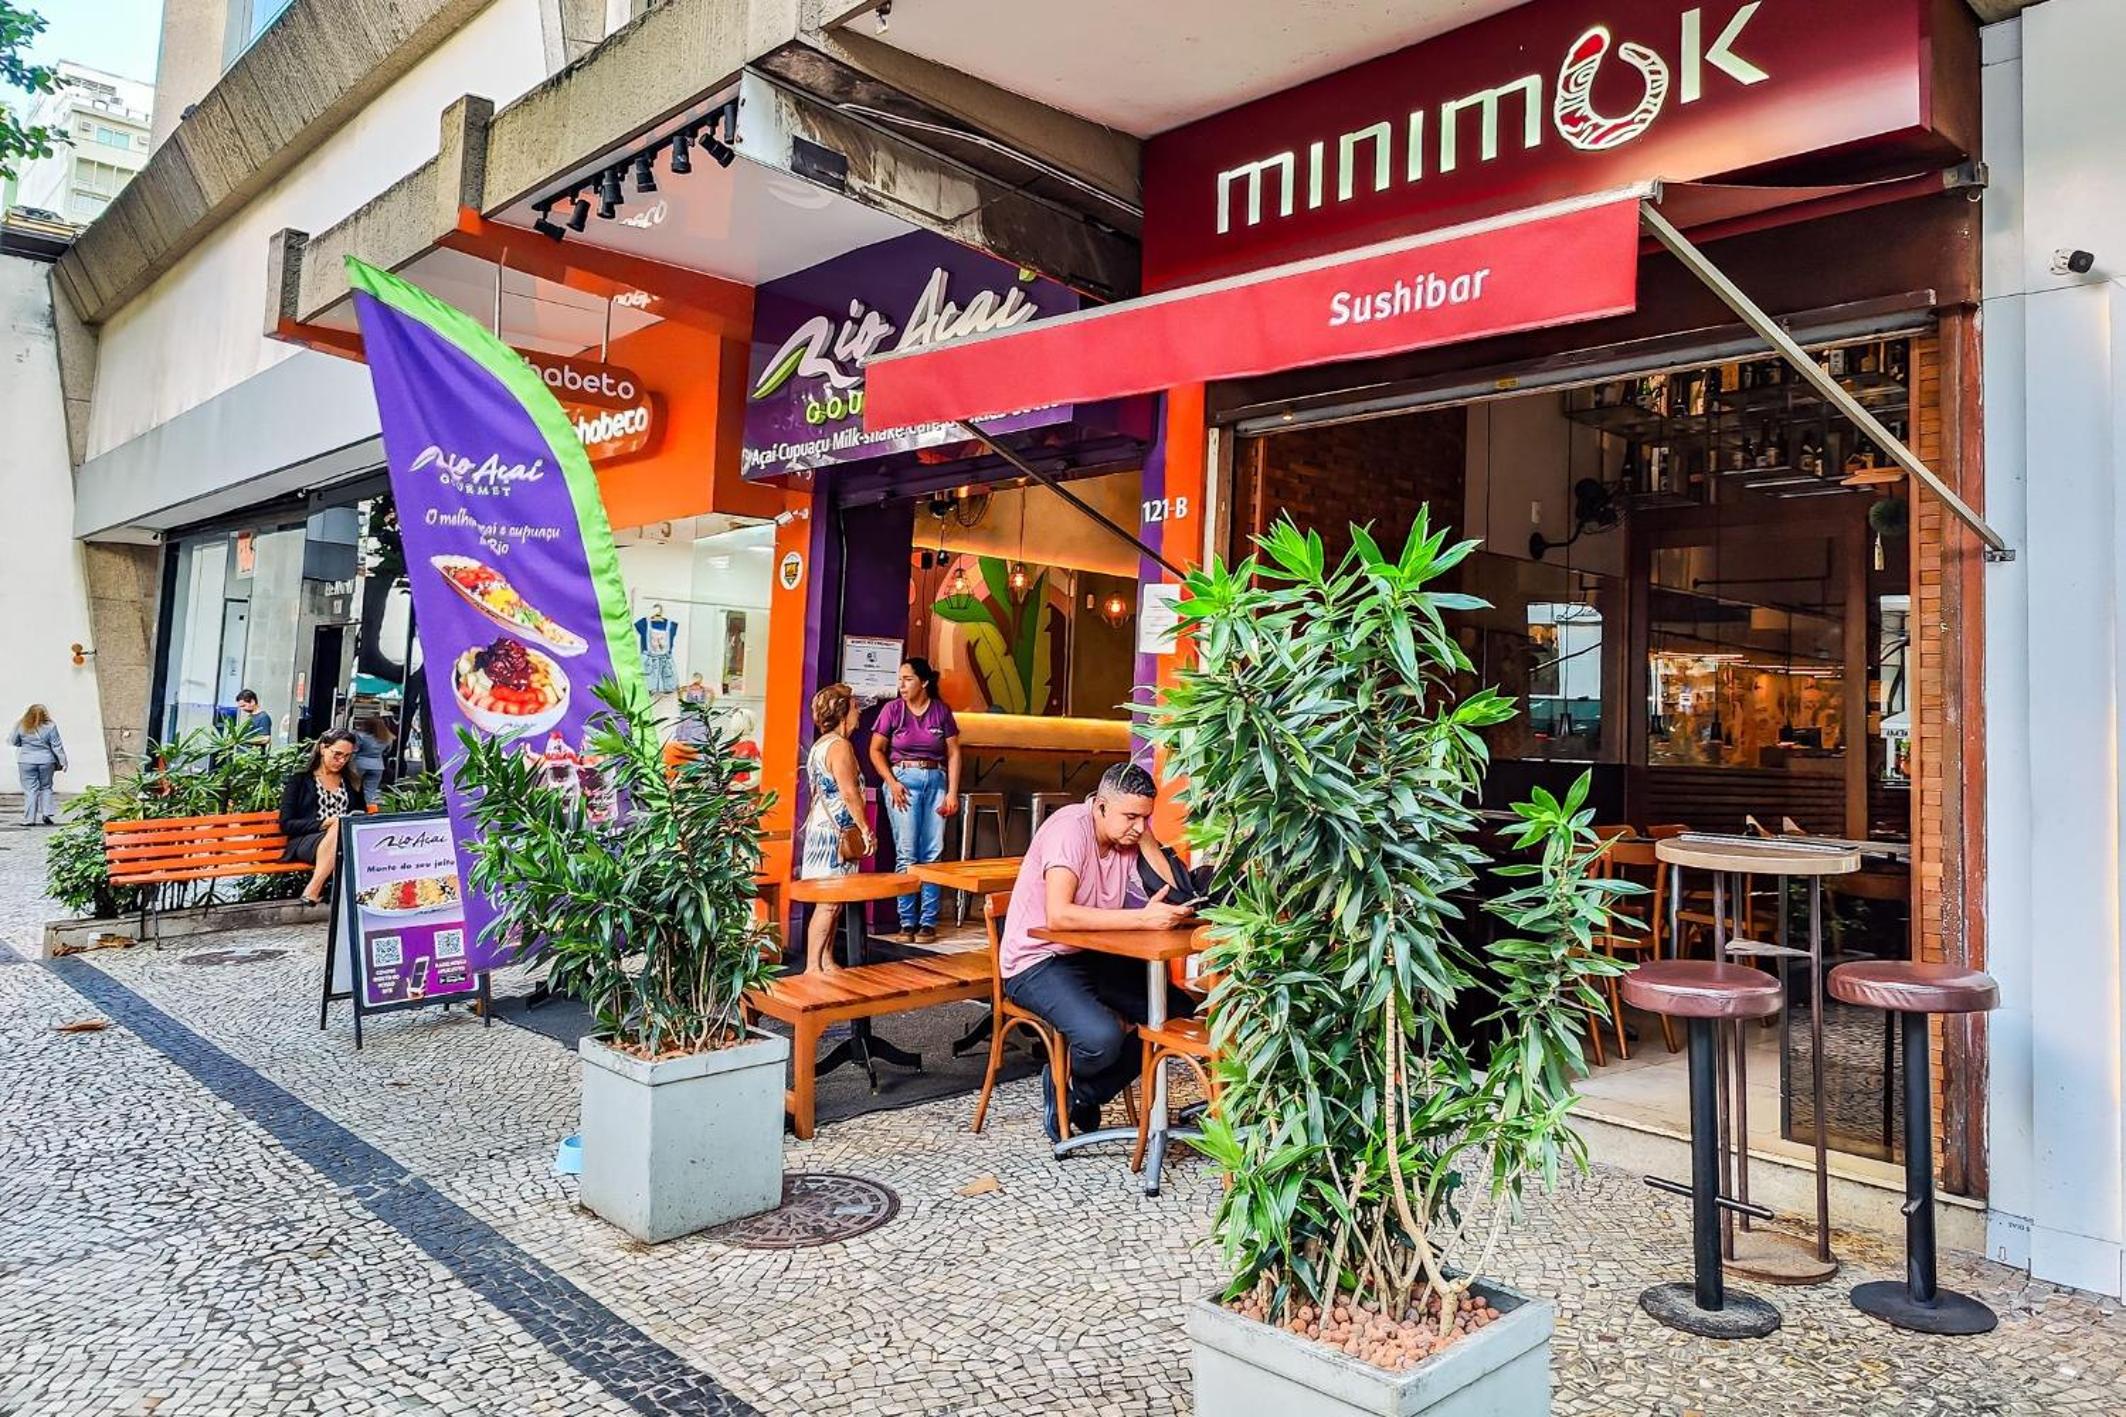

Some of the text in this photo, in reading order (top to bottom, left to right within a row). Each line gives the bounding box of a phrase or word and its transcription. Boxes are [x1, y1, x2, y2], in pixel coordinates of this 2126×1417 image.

[1328, 266, 1492, 327] Sushibar
[778, 437, 830, 464] Cupuaçu
[1142, 496, 1188, 522] 121-B
[425, 508, 438, 525] O
[509, 523, 561, 544] cupuaçu
[487, 538, 510, 556] Rio
[366, 864, 397, 873] Monte
[400, 862, 413, 870] do
[415, 862, 432, 870] seu
